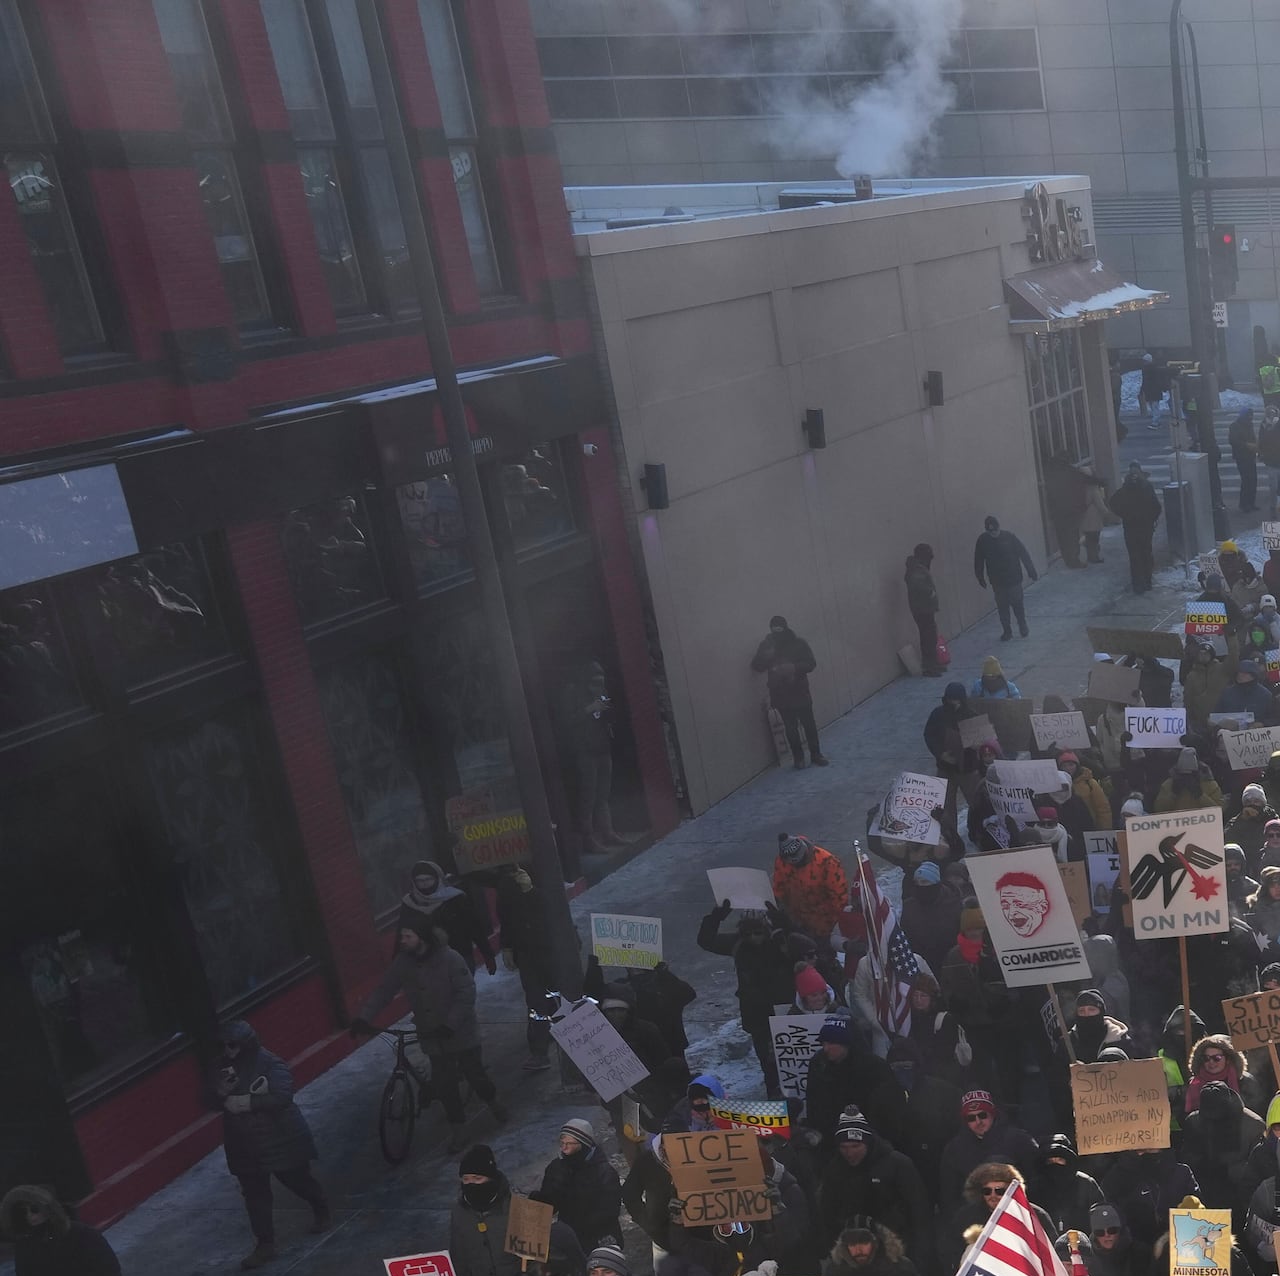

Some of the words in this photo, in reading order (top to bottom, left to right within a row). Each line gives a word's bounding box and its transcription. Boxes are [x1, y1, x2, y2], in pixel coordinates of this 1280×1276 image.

[1131, 817, 1166, 831] DON'T
[1173, 814, 1215, 829] TREAD
[1140, 915, 1174, 931] ON
[1183, 909, 1221, 928] MN
[1001, 947, 1082, 968] COWARDICE
[680, 1133, 748, 1165] ICE
[683, 1189, 768, 1222] GESTAPO
